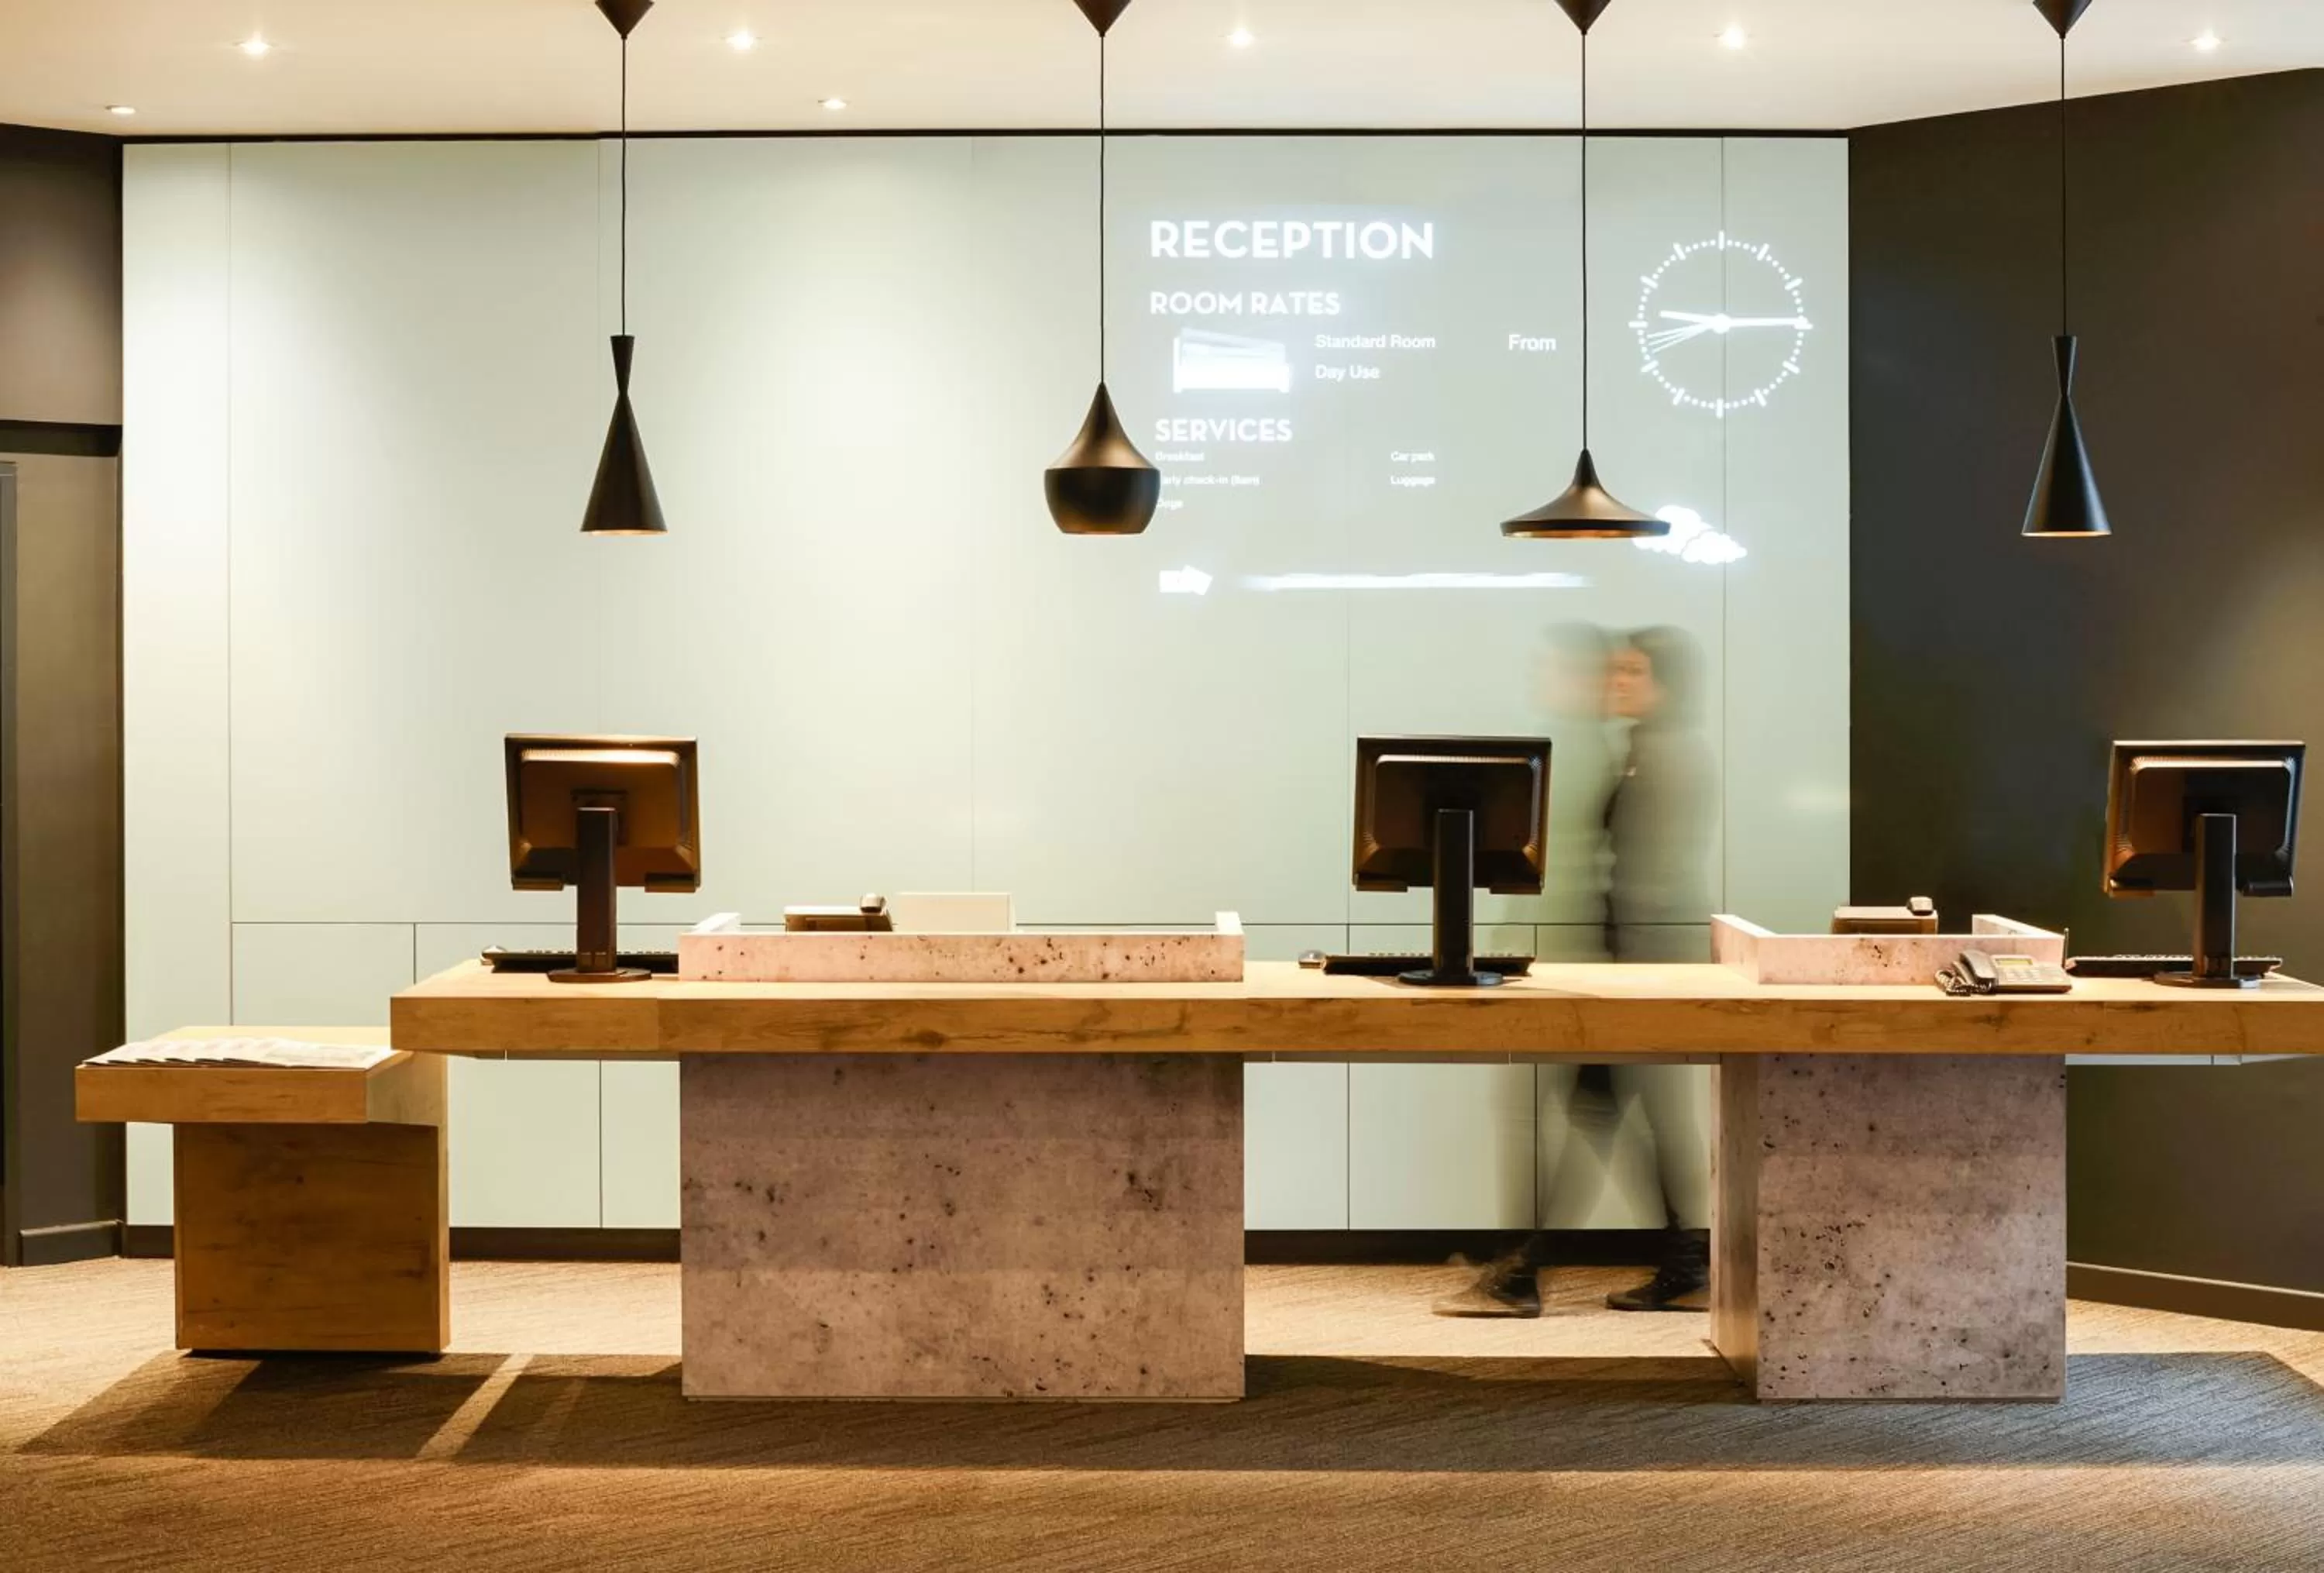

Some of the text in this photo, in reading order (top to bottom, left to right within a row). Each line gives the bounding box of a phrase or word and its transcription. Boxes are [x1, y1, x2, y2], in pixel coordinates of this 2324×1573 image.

[1150, 220, 1434, 260] RECEPTION
[1150, 291, 1341, 315] ROOM RATES
[1315, 334, 1435, 348] Standard Room
[1508, 333, 1556, 351] From
[1315, 364, 1380, 382] Day Use
[1155, 418, 1293, 442] SERVICES
[1160, 474, 1181, 487] arly
